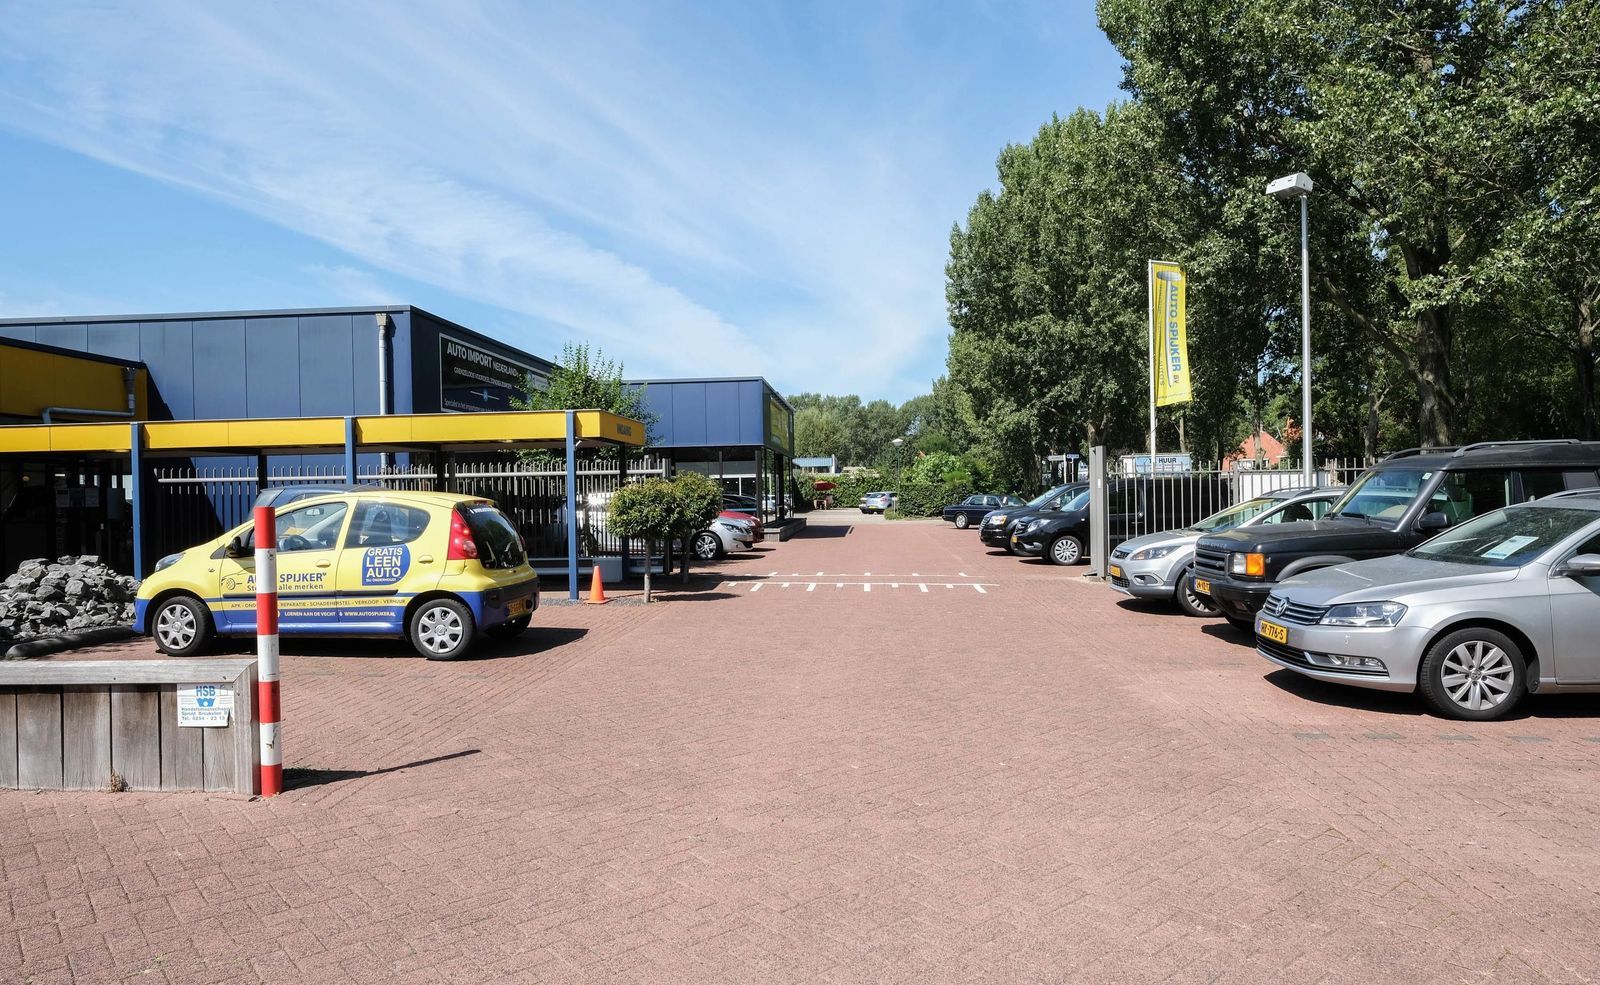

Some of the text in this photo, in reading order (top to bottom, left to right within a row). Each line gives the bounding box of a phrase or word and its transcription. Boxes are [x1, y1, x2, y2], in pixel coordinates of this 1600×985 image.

[1169, 284, 1178, 318] AUTO
[1169, 321, 1181, 372] SPIJKER
[447, 342, 467, 360] AUTO
[467, 350, 493, 369] IMPORT
[367, 547, 403, 556] GRATIS
[366, 556, 401, 568] LEEN
[279, 572, 323, 583] SPIJKER
[366, 567, 402, 578] AUTO
[278, 582, 324, 591] alle merken
[195, 685, 216, 697] HSB
